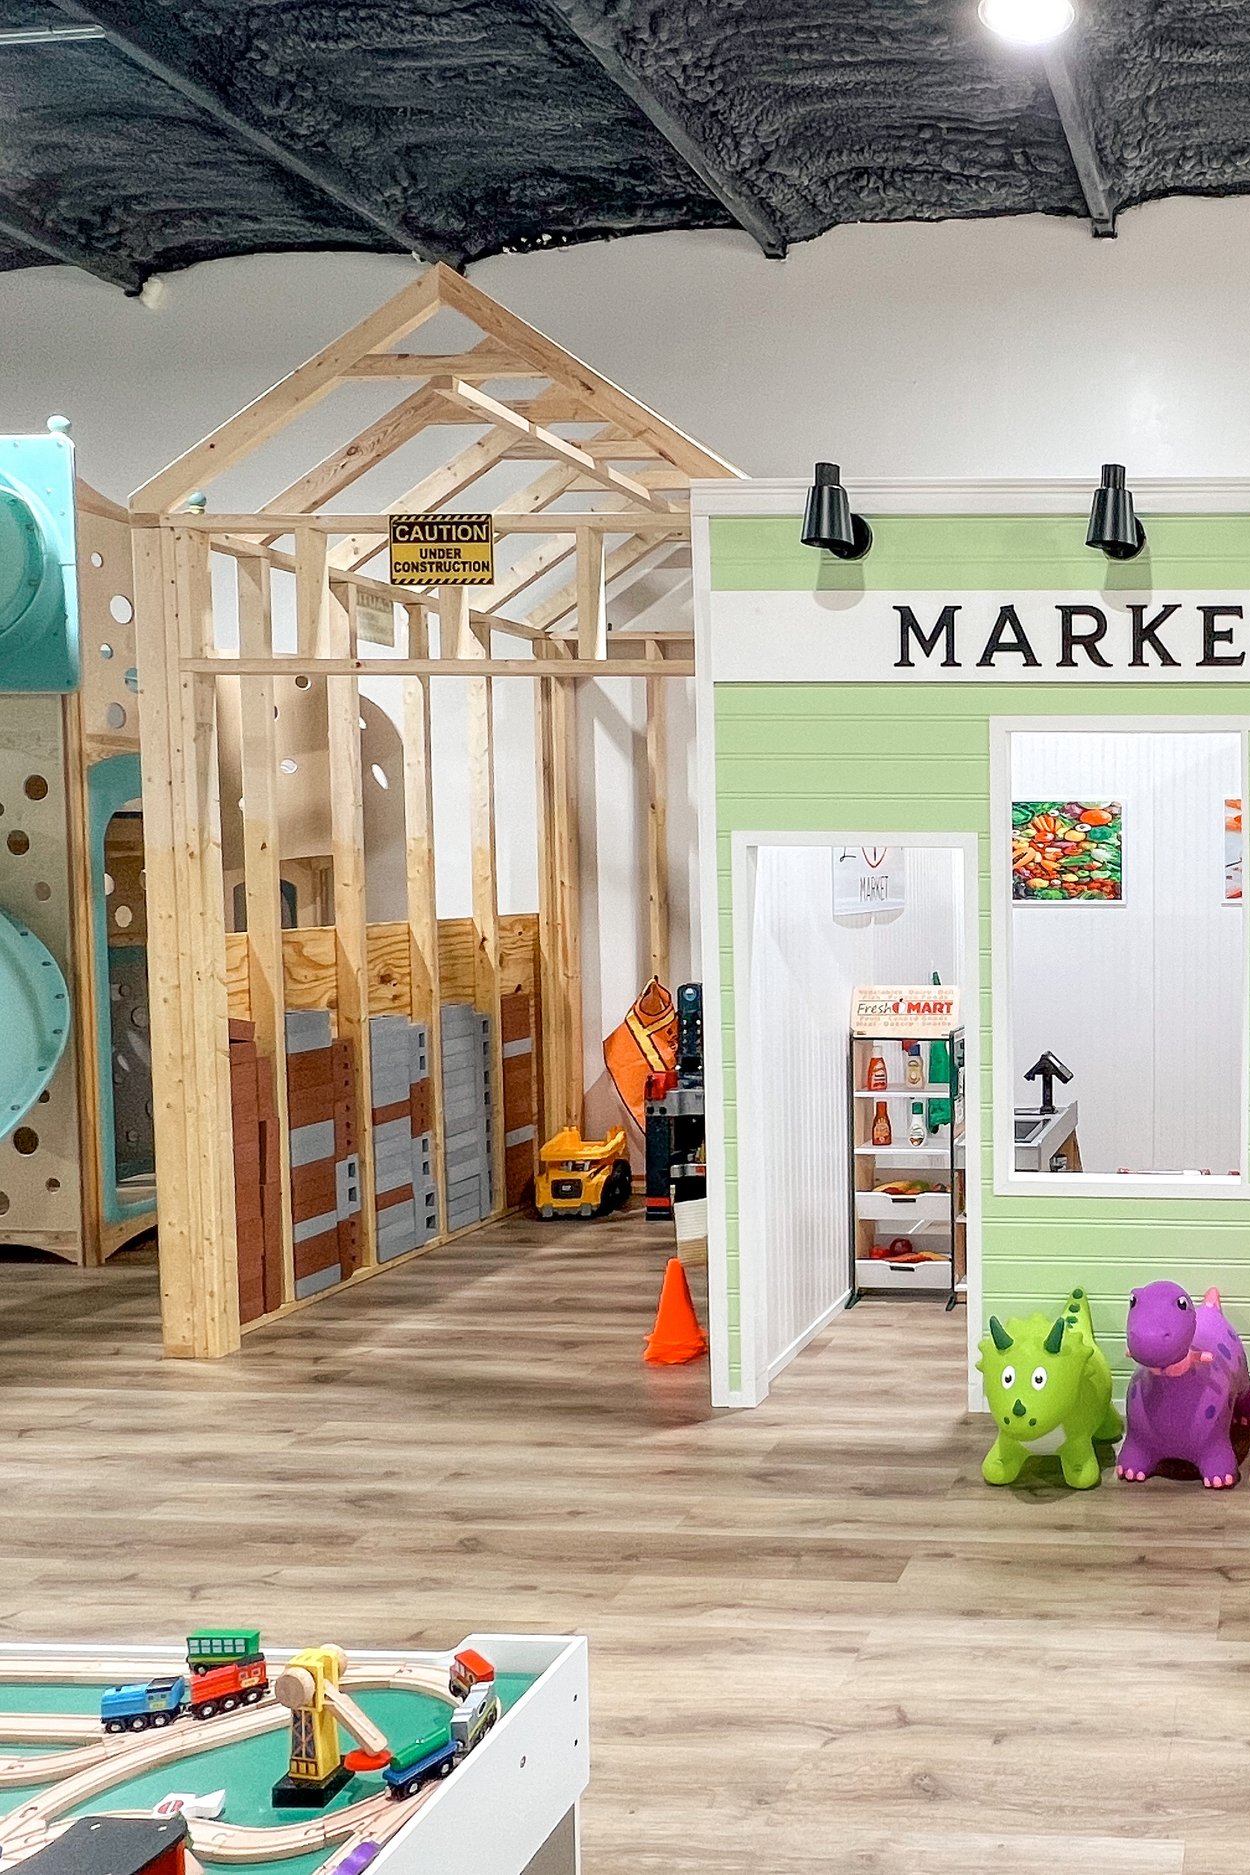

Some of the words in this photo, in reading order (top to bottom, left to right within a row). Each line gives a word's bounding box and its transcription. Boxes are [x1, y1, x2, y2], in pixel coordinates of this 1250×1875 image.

[395, 524, 487, 541] CAUTION
[420, 548, 462, 559] UNDER
[394, 561, 490, 573] CONSTRUCTION
[860, 875, 888, 902] MARKET
[857, 1002, 892, 1014] Fresh
[907, 1001, 953, 1014] MART
